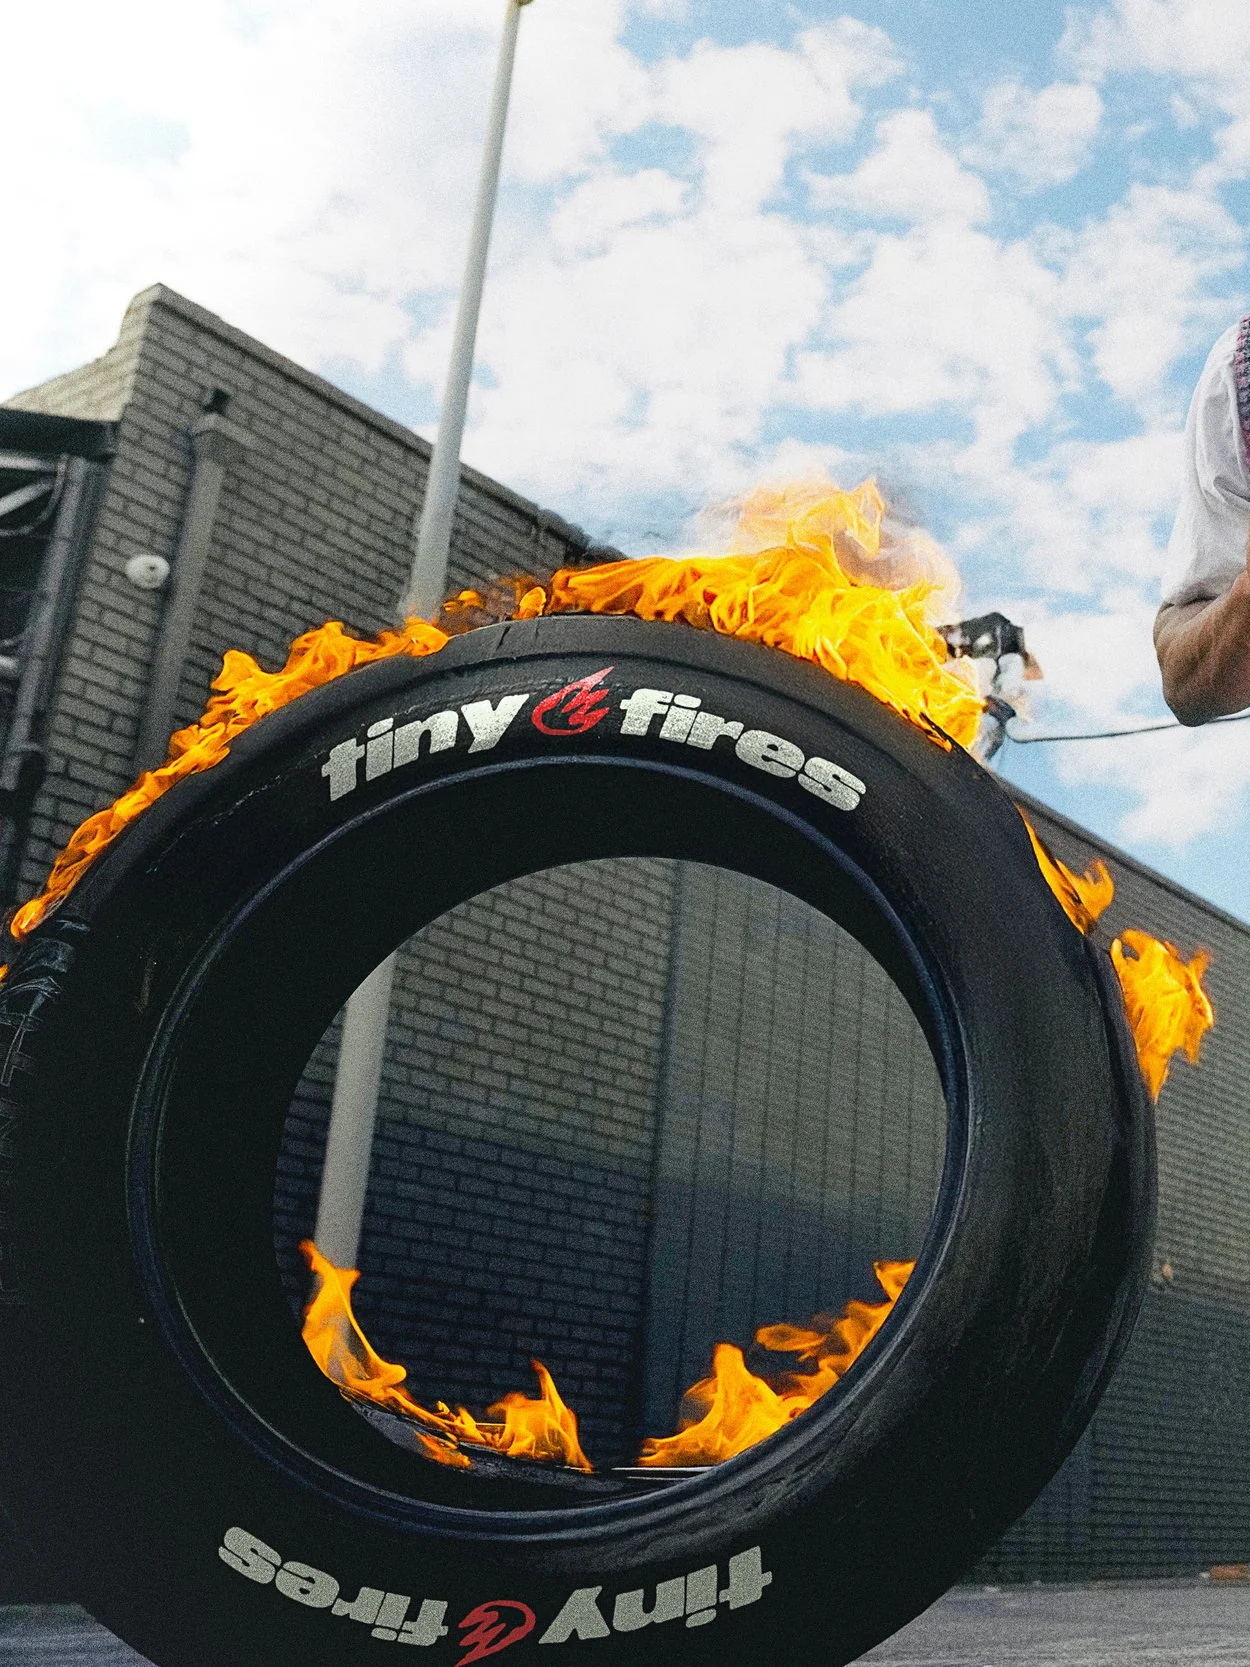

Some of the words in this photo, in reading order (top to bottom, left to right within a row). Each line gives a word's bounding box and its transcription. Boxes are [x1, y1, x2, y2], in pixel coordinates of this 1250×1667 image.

[321, 693, 530, 802] tiny
[619, 687, 868, 813] fires
[218, 1526, 449, 1647] fires
[538, 1545, 773, 1644] tiny
